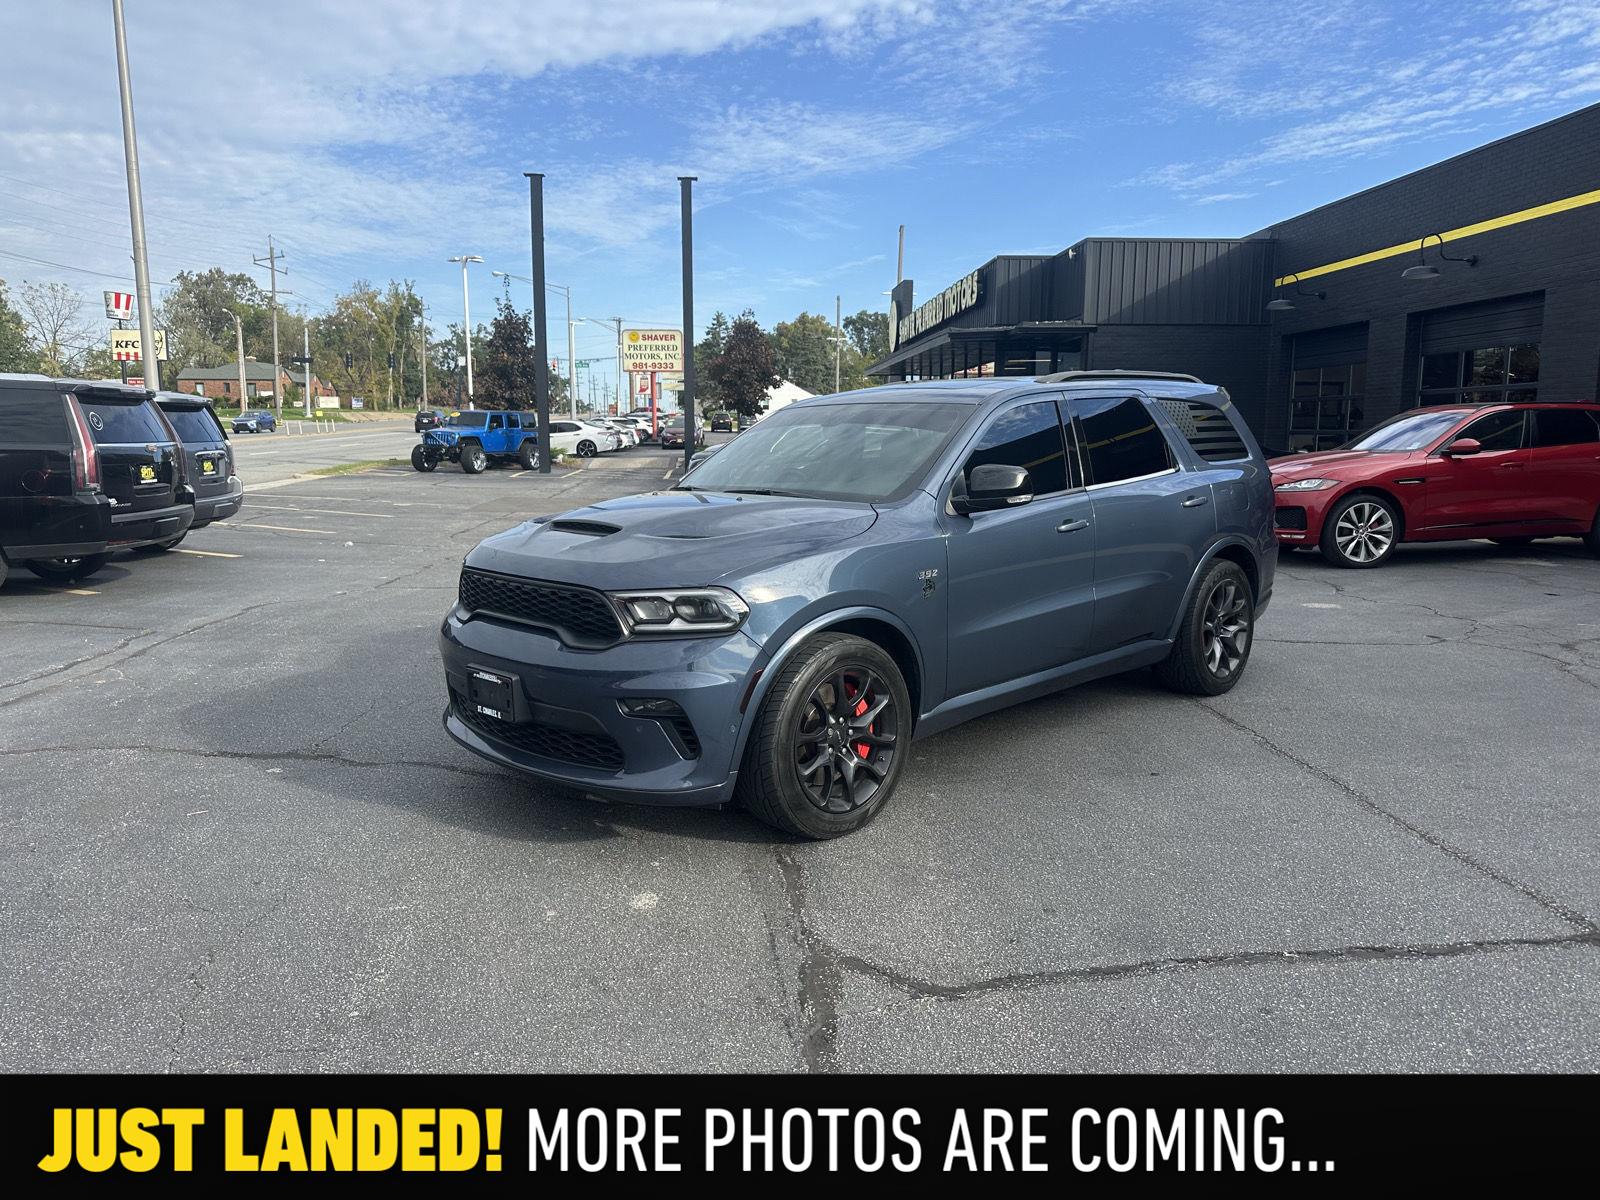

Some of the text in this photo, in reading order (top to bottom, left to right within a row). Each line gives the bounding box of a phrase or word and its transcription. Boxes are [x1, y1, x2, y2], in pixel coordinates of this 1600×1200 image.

[944, 270, 978, 320] MOTORS
[115, 340, 139, 348] KFC
[624, 353, 663, 361] MOTORS,
[918, 569, 938, 579] 392
